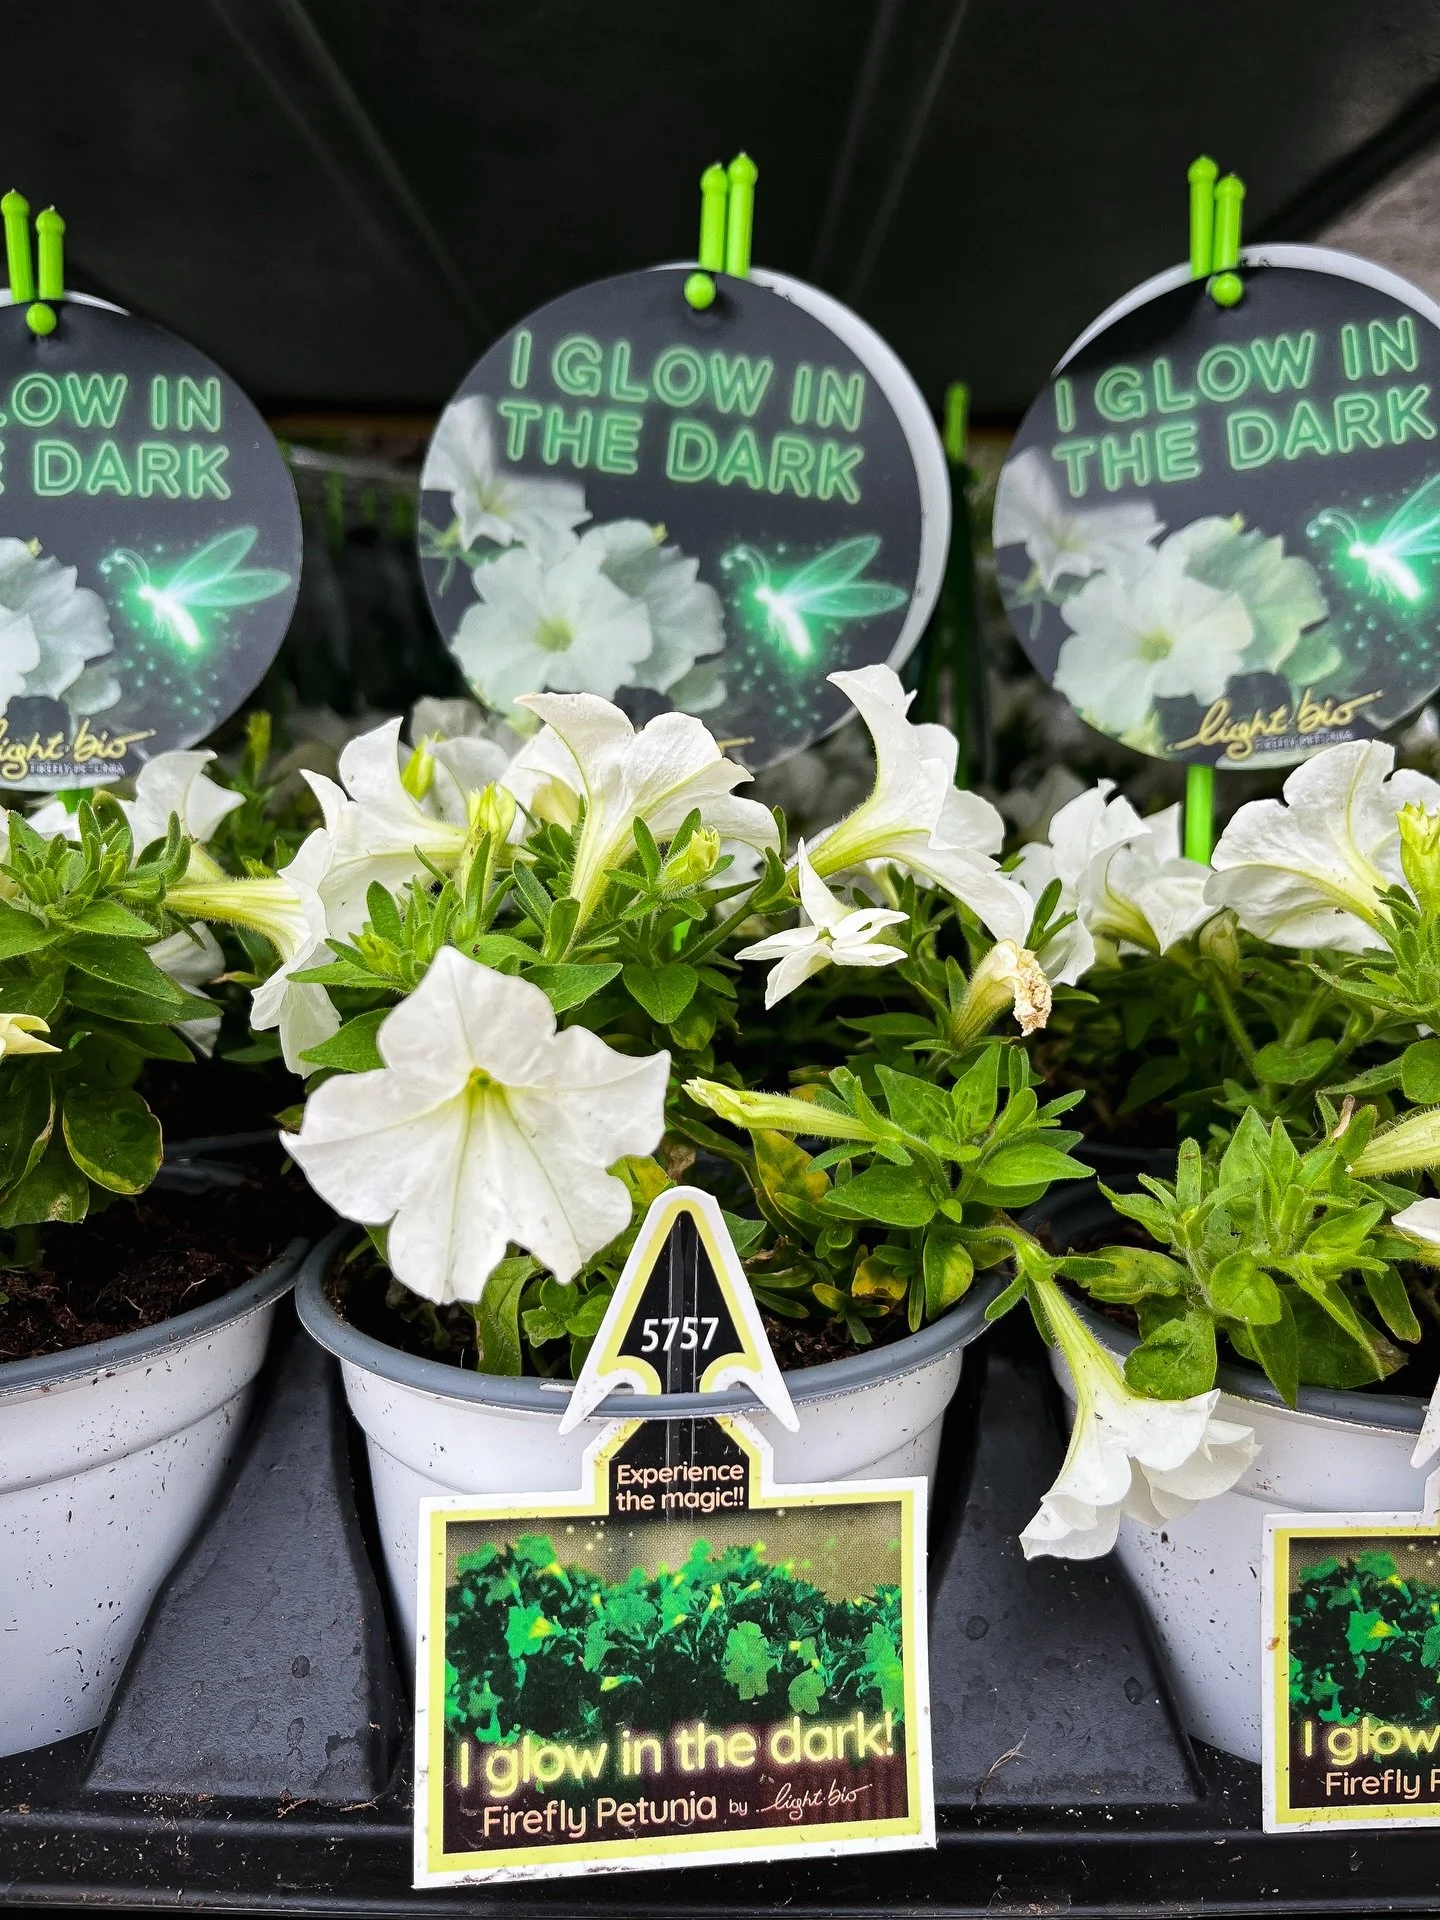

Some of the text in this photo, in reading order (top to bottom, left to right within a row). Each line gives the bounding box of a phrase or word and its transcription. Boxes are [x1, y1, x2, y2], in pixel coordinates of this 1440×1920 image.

[0, 372, 222, 433] OW IN
[510, 330, 864, 432] I GLOW IN
[1054, 316, 1418, 433] I GLOW IN
[33, 439, 232, 500] DARK
[498, 400, 864, 505] THE DARK
[1051, 383, 1437, 498] THE DARK
[641, 1316, 719, 1352] 5757
[616, 1486, 744, 1513] the magic!!
[617, 1461, 745, 1488] Experience
[460, 1711, 894, 1798] I glow in the dark!
[1304, 1716, 1440, 1766] I glow
[483, 1799, 586, 1838] Firefly
[597, 1790, 717, 1828] Petunia
[729, 1798, 748, 1816] by
[1326, 1768, 1420, 1800] Firefly
